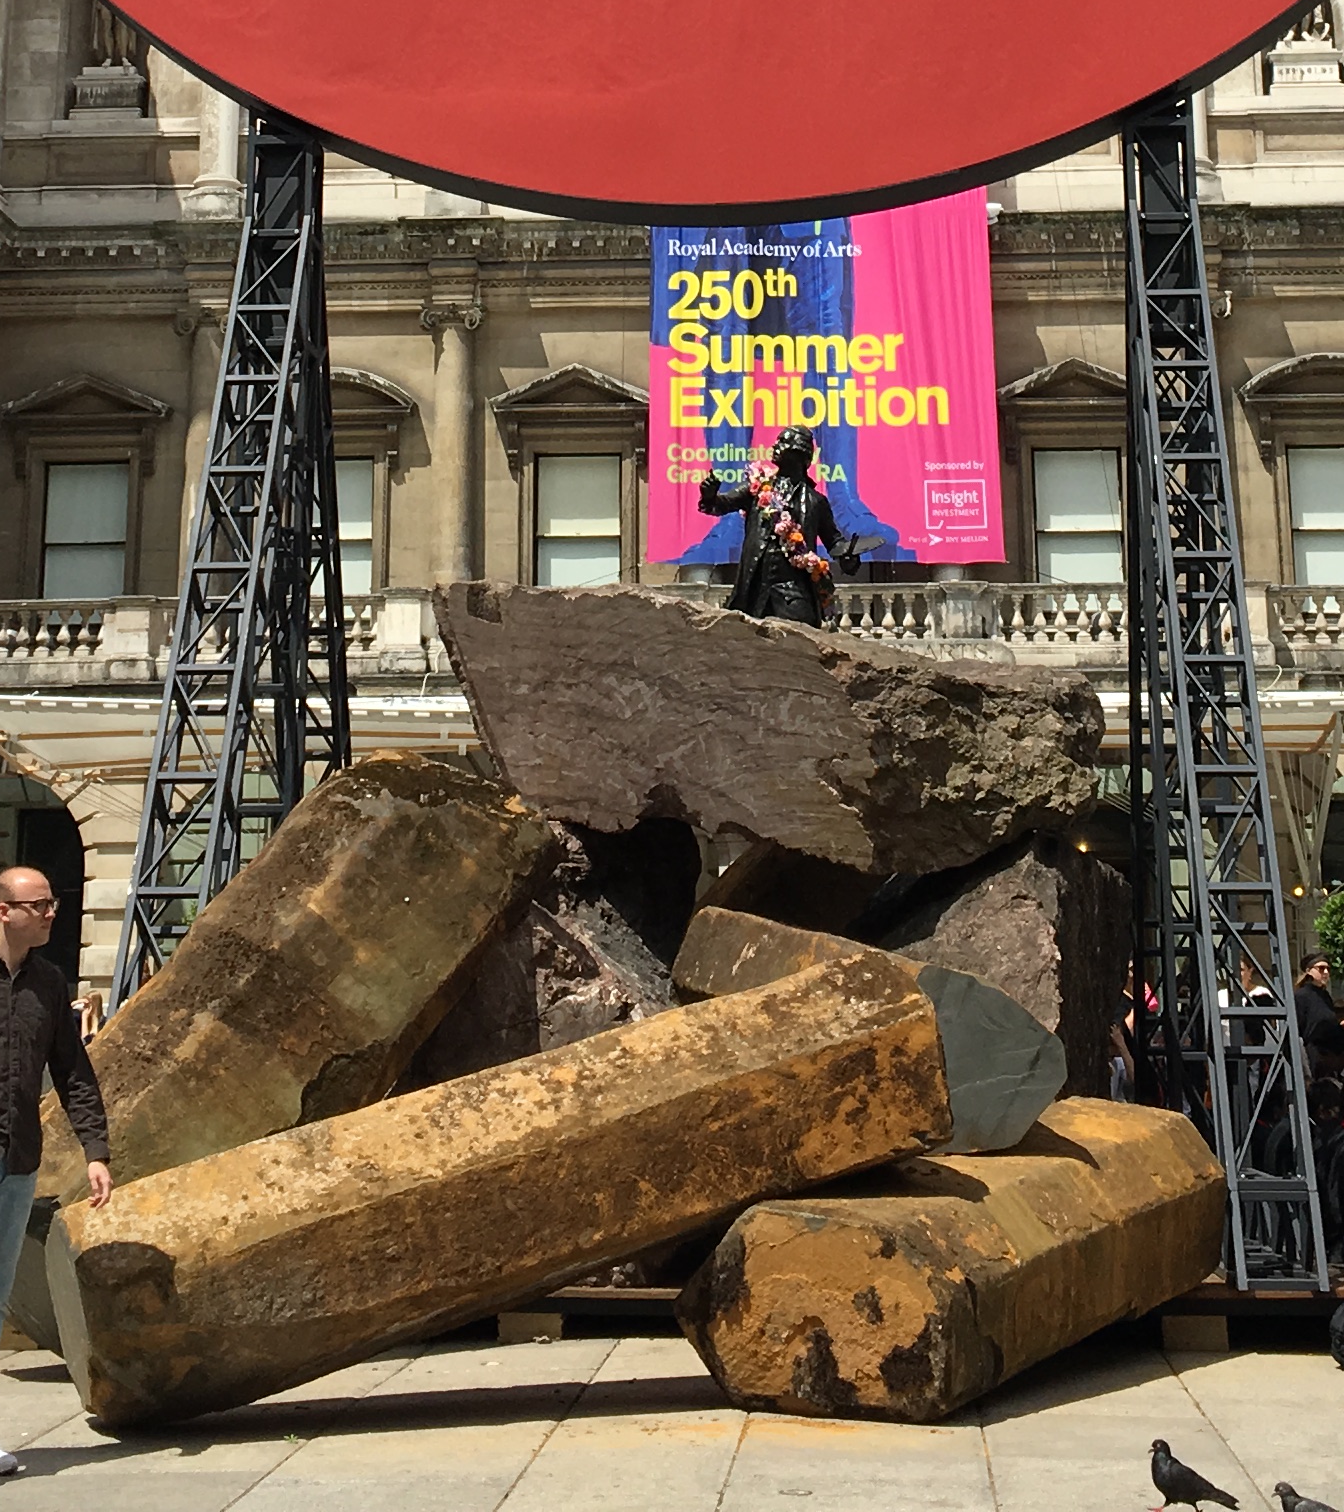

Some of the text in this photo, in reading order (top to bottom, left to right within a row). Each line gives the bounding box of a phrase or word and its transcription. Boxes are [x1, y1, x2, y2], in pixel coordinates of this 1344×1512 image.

[668, 239, 862, 261] Royal Academy of Arts
[668, 268, 797, 320] 250th
[667, 322, 904, 374] Summer
[670, 376, 950, 428] Exhibition
[666, 443, 775, 462] Coordinate
[815, 464, 847, 482] RA
[924, 460, 984, 472] Sponsored by
[931, 489, 980, 508] Insight
[932, 508, 980, 517] INVESTMENT
